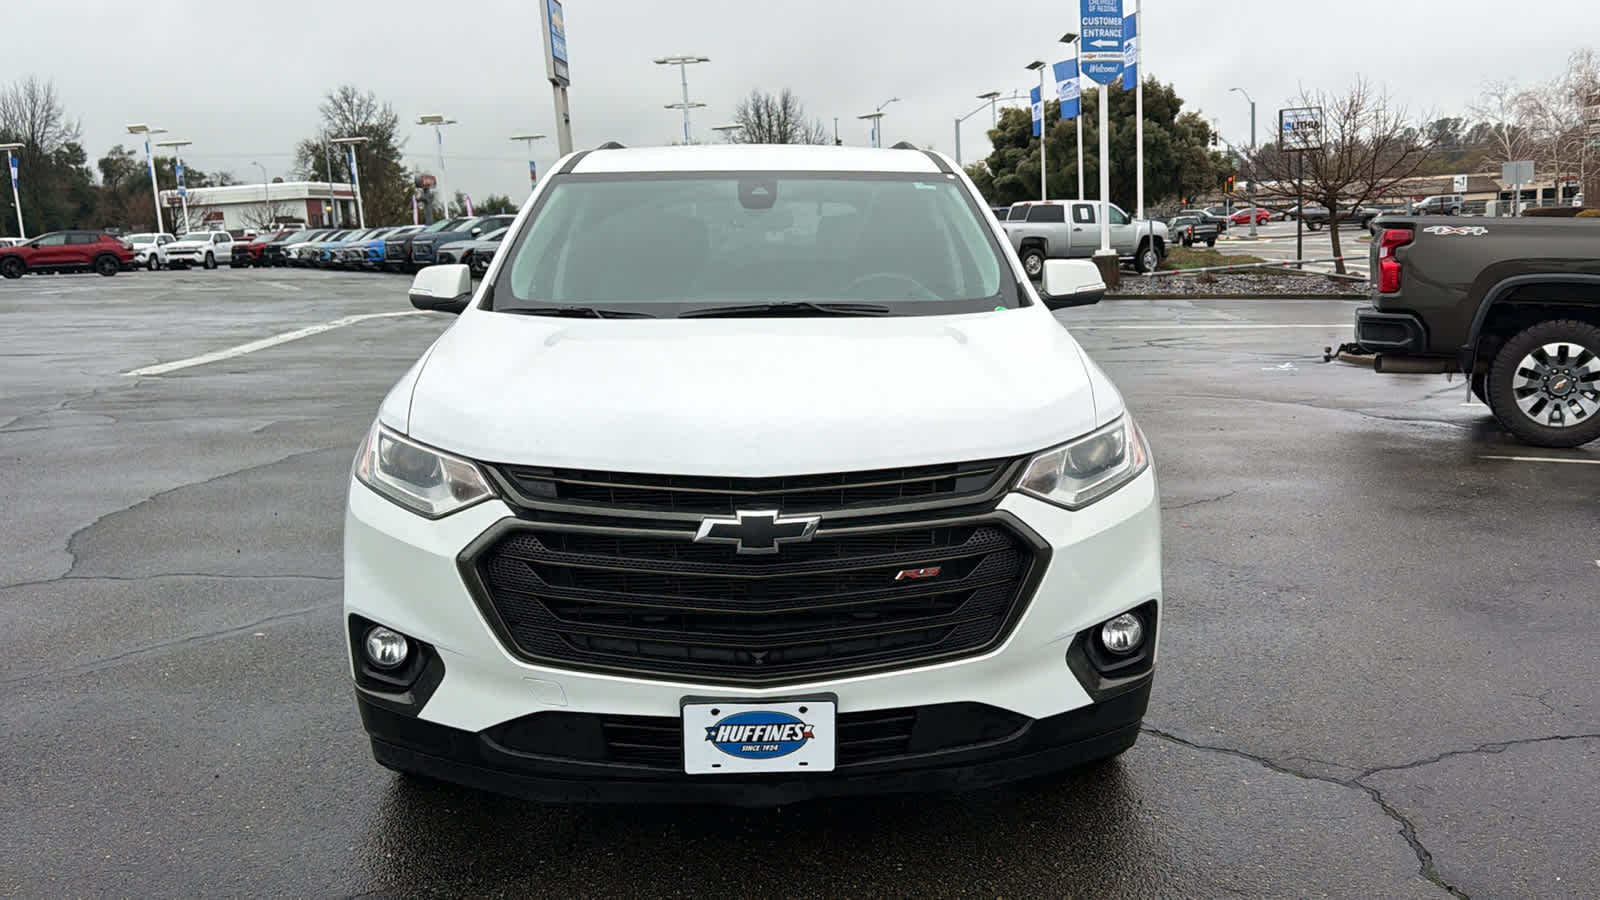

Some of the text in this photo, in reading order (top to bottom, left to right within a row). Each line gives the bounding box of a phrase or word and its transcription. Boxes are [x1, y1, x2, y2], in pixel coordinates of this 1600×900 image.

[1082, 16, 1122, 25] CUSTOMER
[1083, 28, 1122, 38] ENTRANCE
[894, 567, 941, 580] RS
[715, 723, 805, 742] HUFFINES
[741, 744, 778, 752] SINCE 1924
